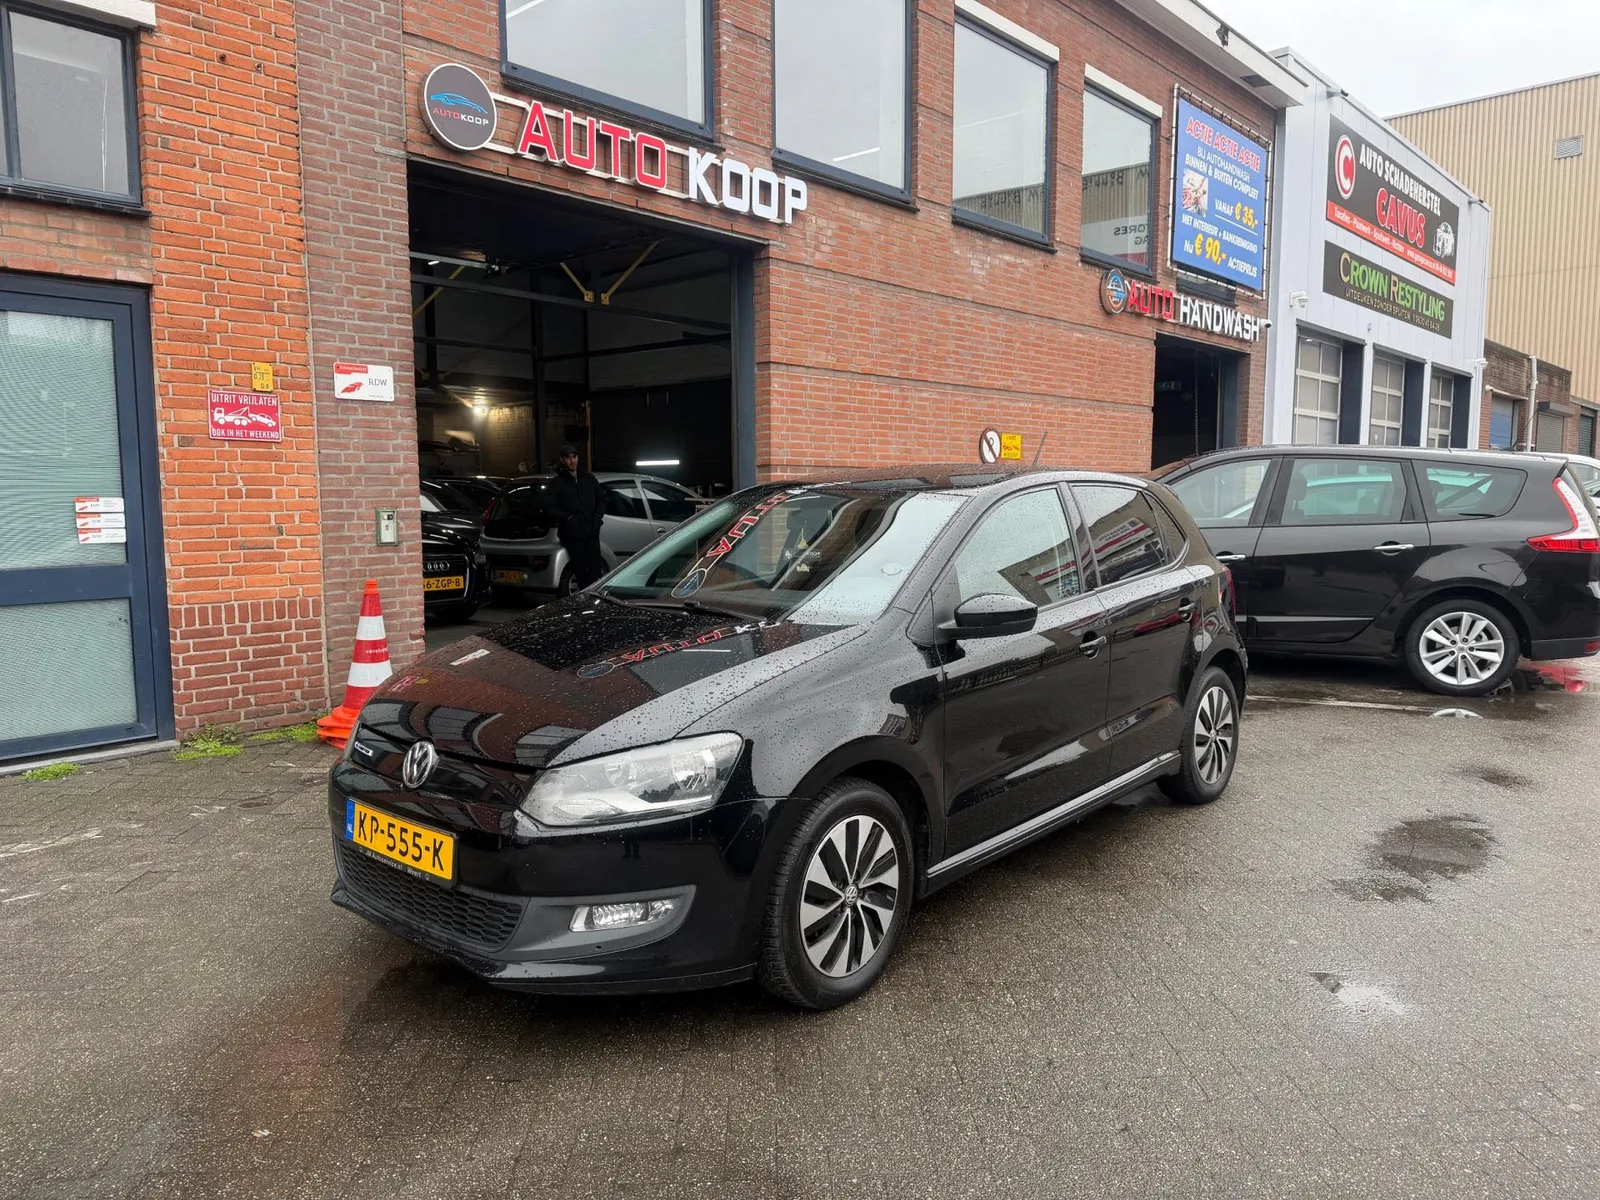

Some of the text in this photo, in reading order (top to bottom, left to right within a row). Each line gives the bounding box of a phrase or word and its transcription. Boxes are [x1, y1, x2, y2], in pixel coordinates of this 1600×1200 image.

[433, 108, 489, 126] AUTOKOOP
[517, 100, 808, 225] AUTO KOOP
[1186, 117, 1260, 173] ACTIE ACTIE ACTIE
[1185, 153, 1259, 200] BINNEN & BUITEN COMPLEET
[1207, 152, 1250, 182] AUTOHANDWASH
[1360, 143, 1441, 216] AUTO SCHADEHERSTEL
[1182, 213, 1193, 226] MET
[1215, 198, 1234, 216] VANAF
[1235, 202, 1241, 220] €
[1376, 188, 1426, 248] CAVUS
[1195, 233, 1203, 256] €
[1340, 252, 1389, 298] CROWN
[1390, 274, 1446, 321] RESTYLING
[1127, 279, 1260, 342] AUTO HANDWASH
[211, 392, 237, 404] UITRIT
[368, 378, 388, 386] RDW
[211, 427, 225, 436] OOK
[236, 429, 248, 437] HET
[249, 430, 279, 438] WEEKEND
[358, 810, 444, 871] KP-555-K
